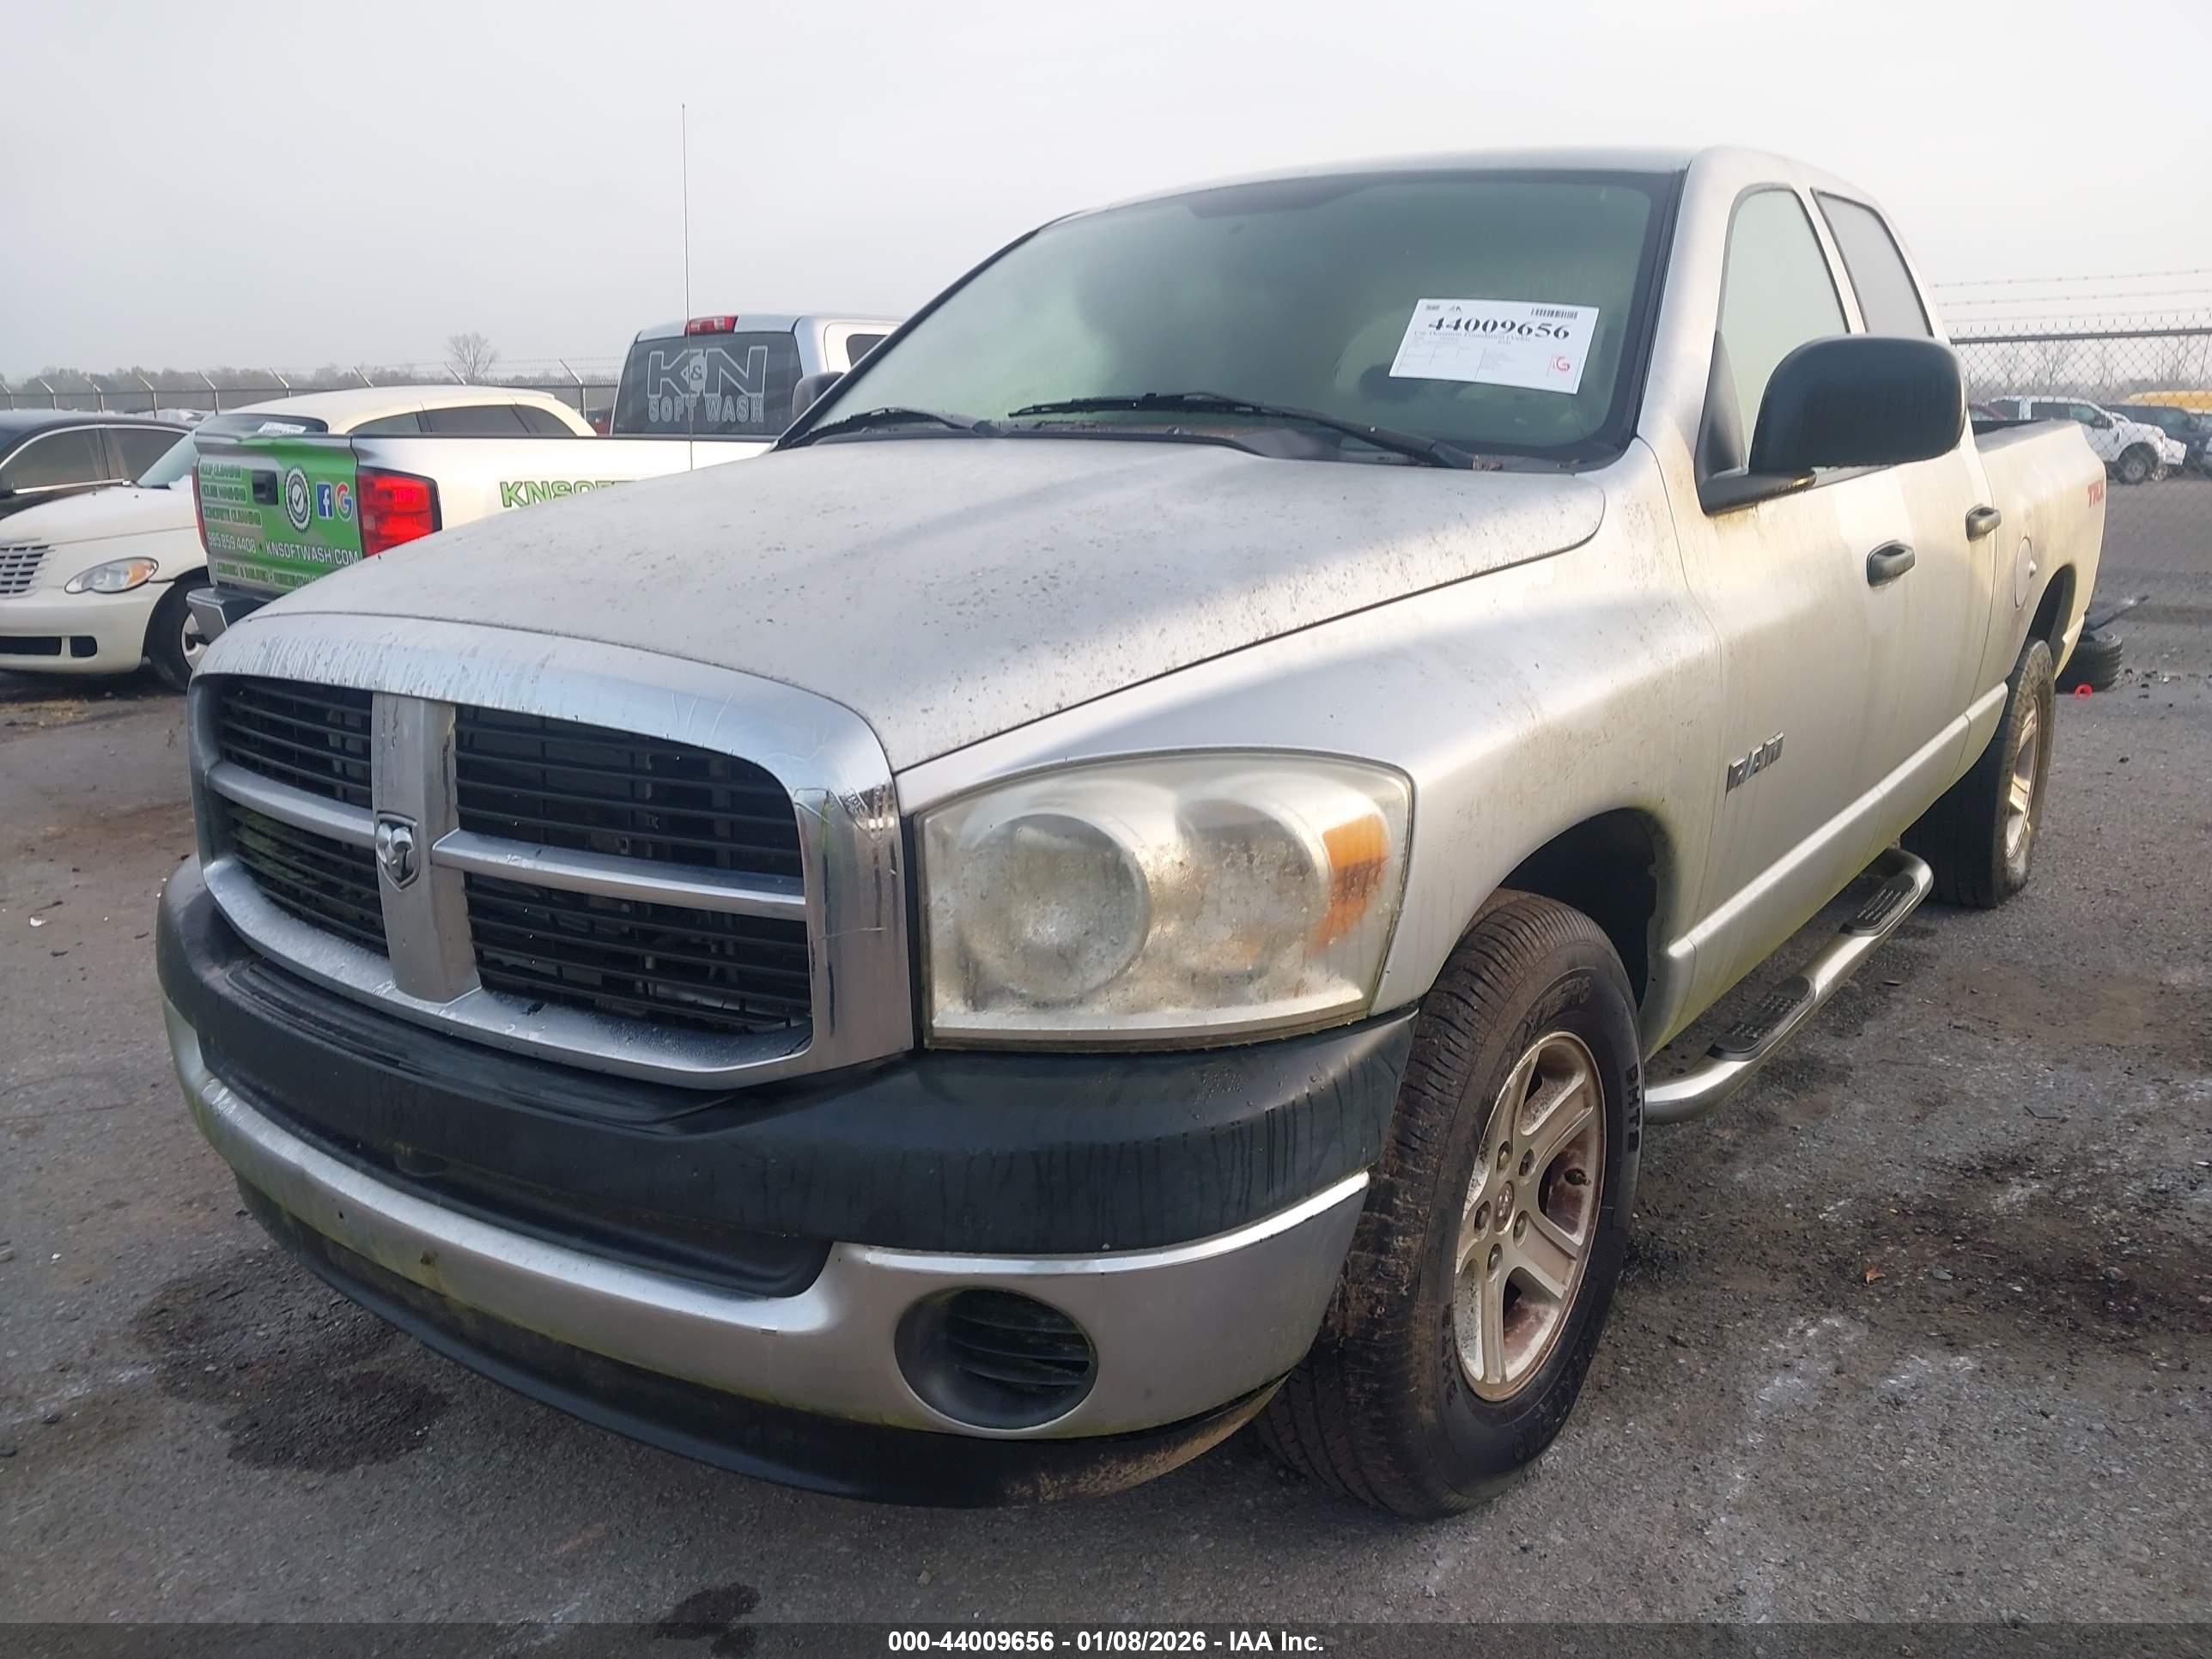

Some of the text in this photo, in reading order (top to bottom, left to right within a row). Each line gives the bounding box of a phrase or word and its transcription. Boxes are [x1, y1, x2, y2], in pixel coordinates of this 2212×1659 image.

[1429, 317, 1570, 340] 44009656
[648, 396, 764, 422] SOFT WASH
[500, 481, 639, 507] KNSO
[265, 542, 358, 566] KNSOFTWASH.COM
